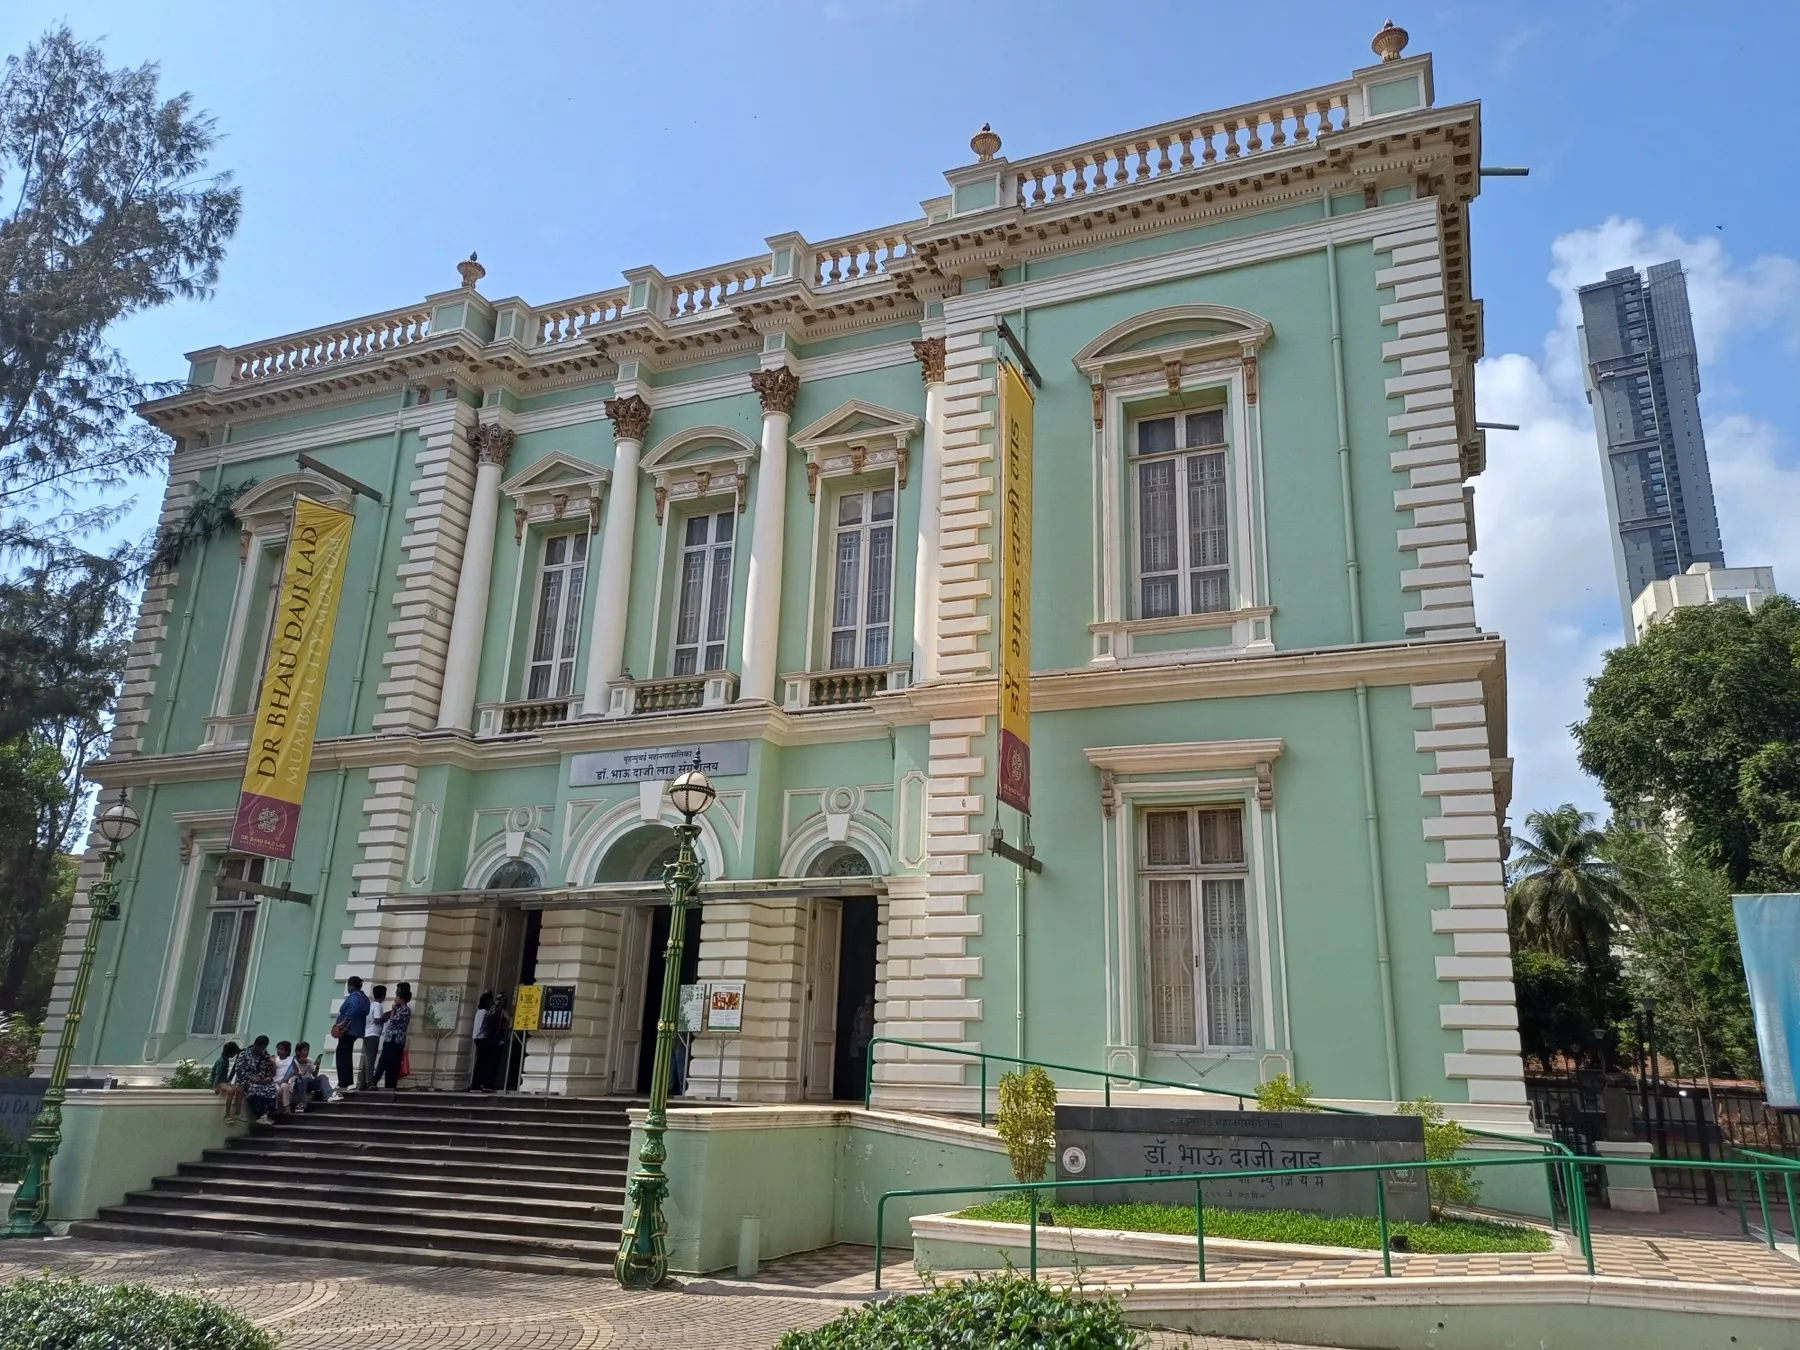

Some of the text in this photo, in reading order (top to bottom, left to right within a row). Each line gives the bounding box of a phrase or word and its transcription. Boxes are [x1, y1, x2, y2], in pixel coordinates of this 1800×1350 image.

[296, 526, 319, 577] LAD
[1004, 413, 1021, 716] डॉ. भाऊ दाजी लाड
[284, 584, 312, 642] DAJI
[286, 537, 341, 785] MUMBAI CITY MUSEUM
[266, 648, 298, 728] BHAU
[257, 736, 282, 779] DR
[596, 761, 719, 780] डॉ. भाऊ दाजी लाड संग्रालय
[648, 749, 693, 760] महानगरपालिका
[1143, 1138, 1322, 1169] डॉ. भाऊ दाजी लाड
